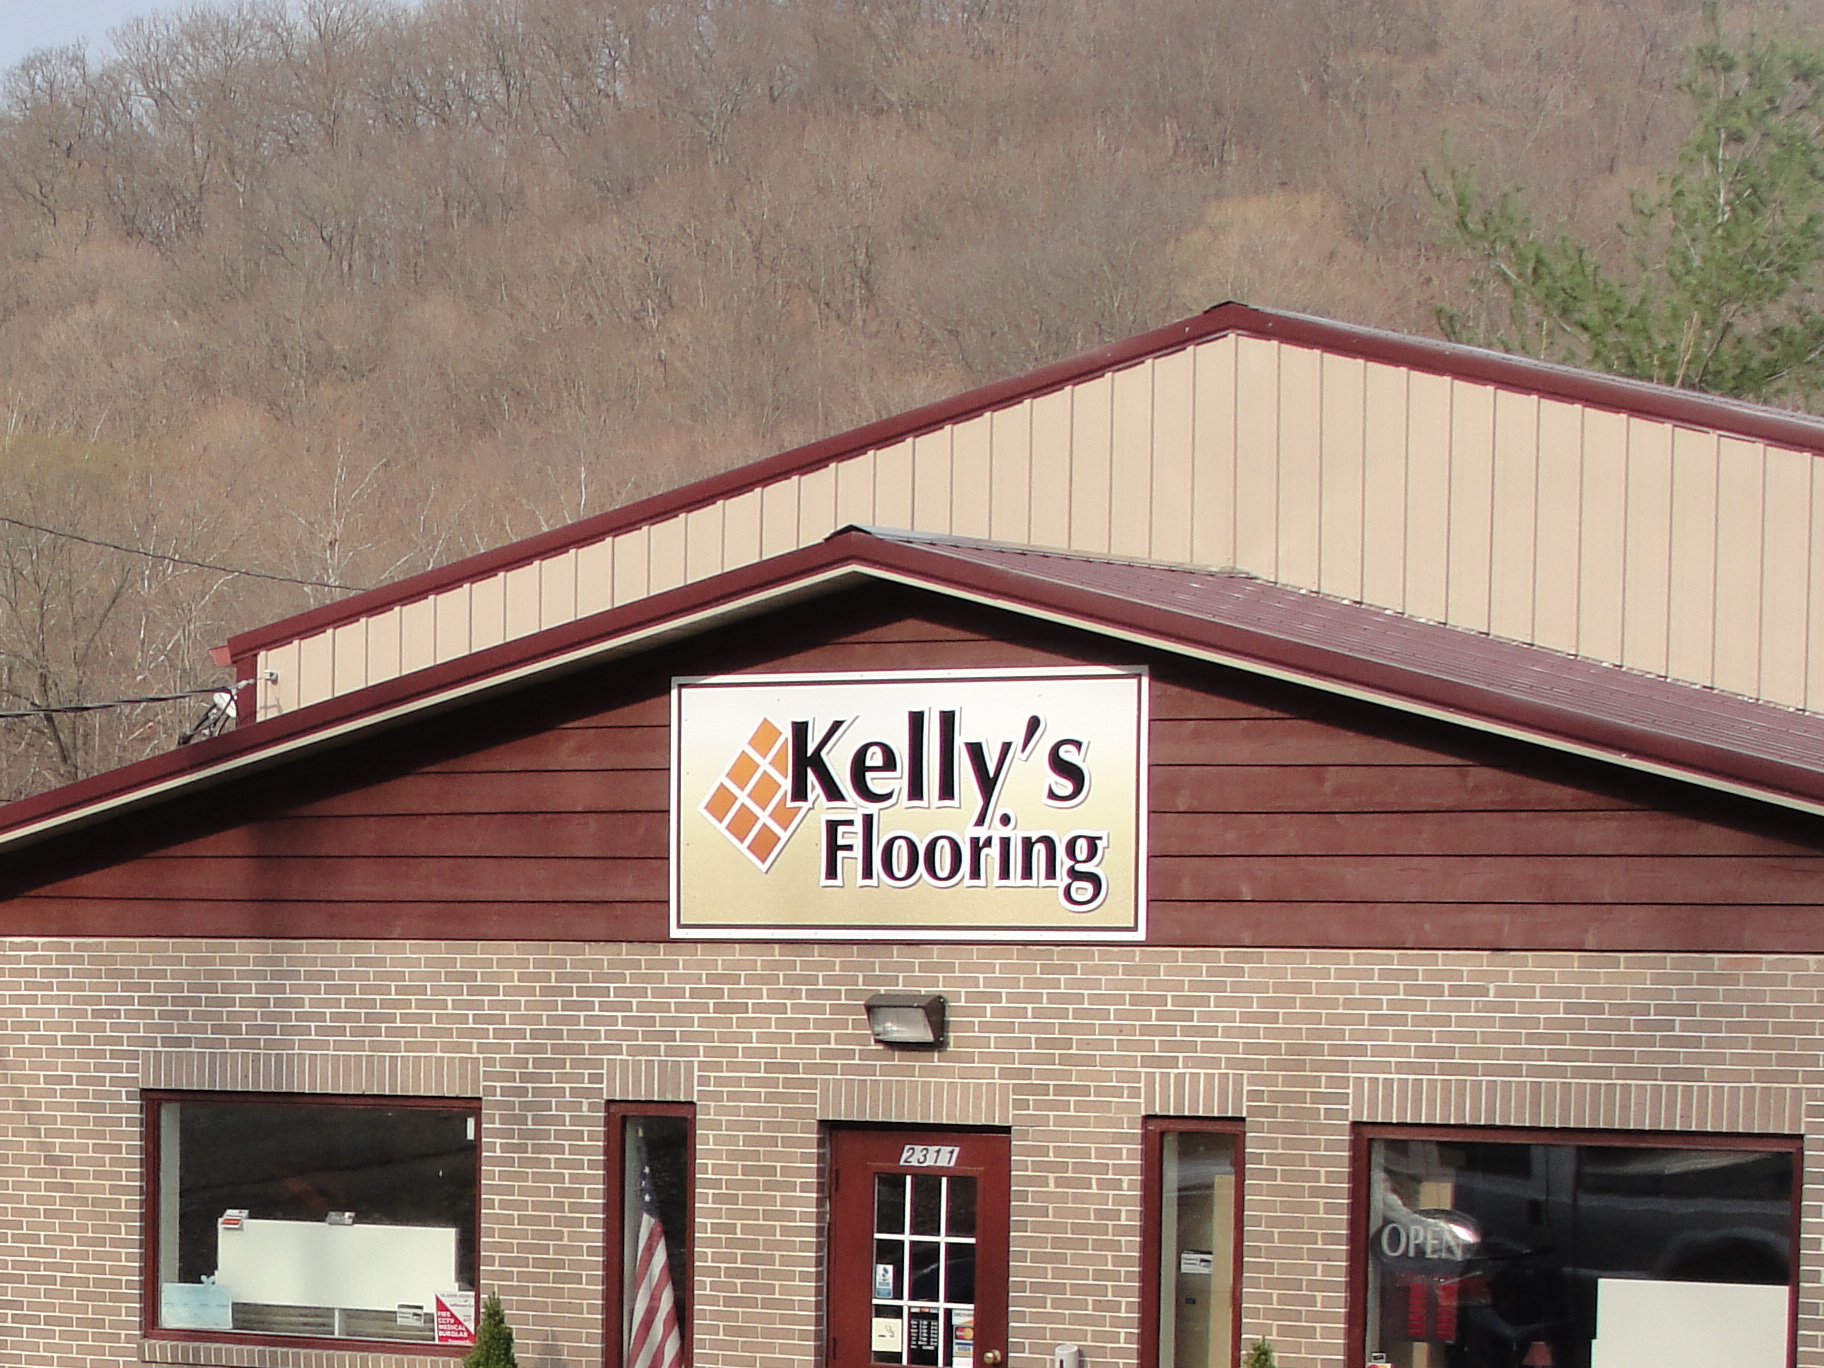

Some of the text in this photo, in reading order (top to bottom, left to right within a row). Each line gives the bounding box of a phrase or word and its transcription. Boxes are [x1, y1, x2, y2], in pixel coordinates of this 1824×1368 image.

[789, 707, 1086, 828] Kelly's
[823, 812, 1106, 907] Flooring
[902, 1146, 956, 1166] 2311
[1380, 1222, 1464, 1262] OPEN
